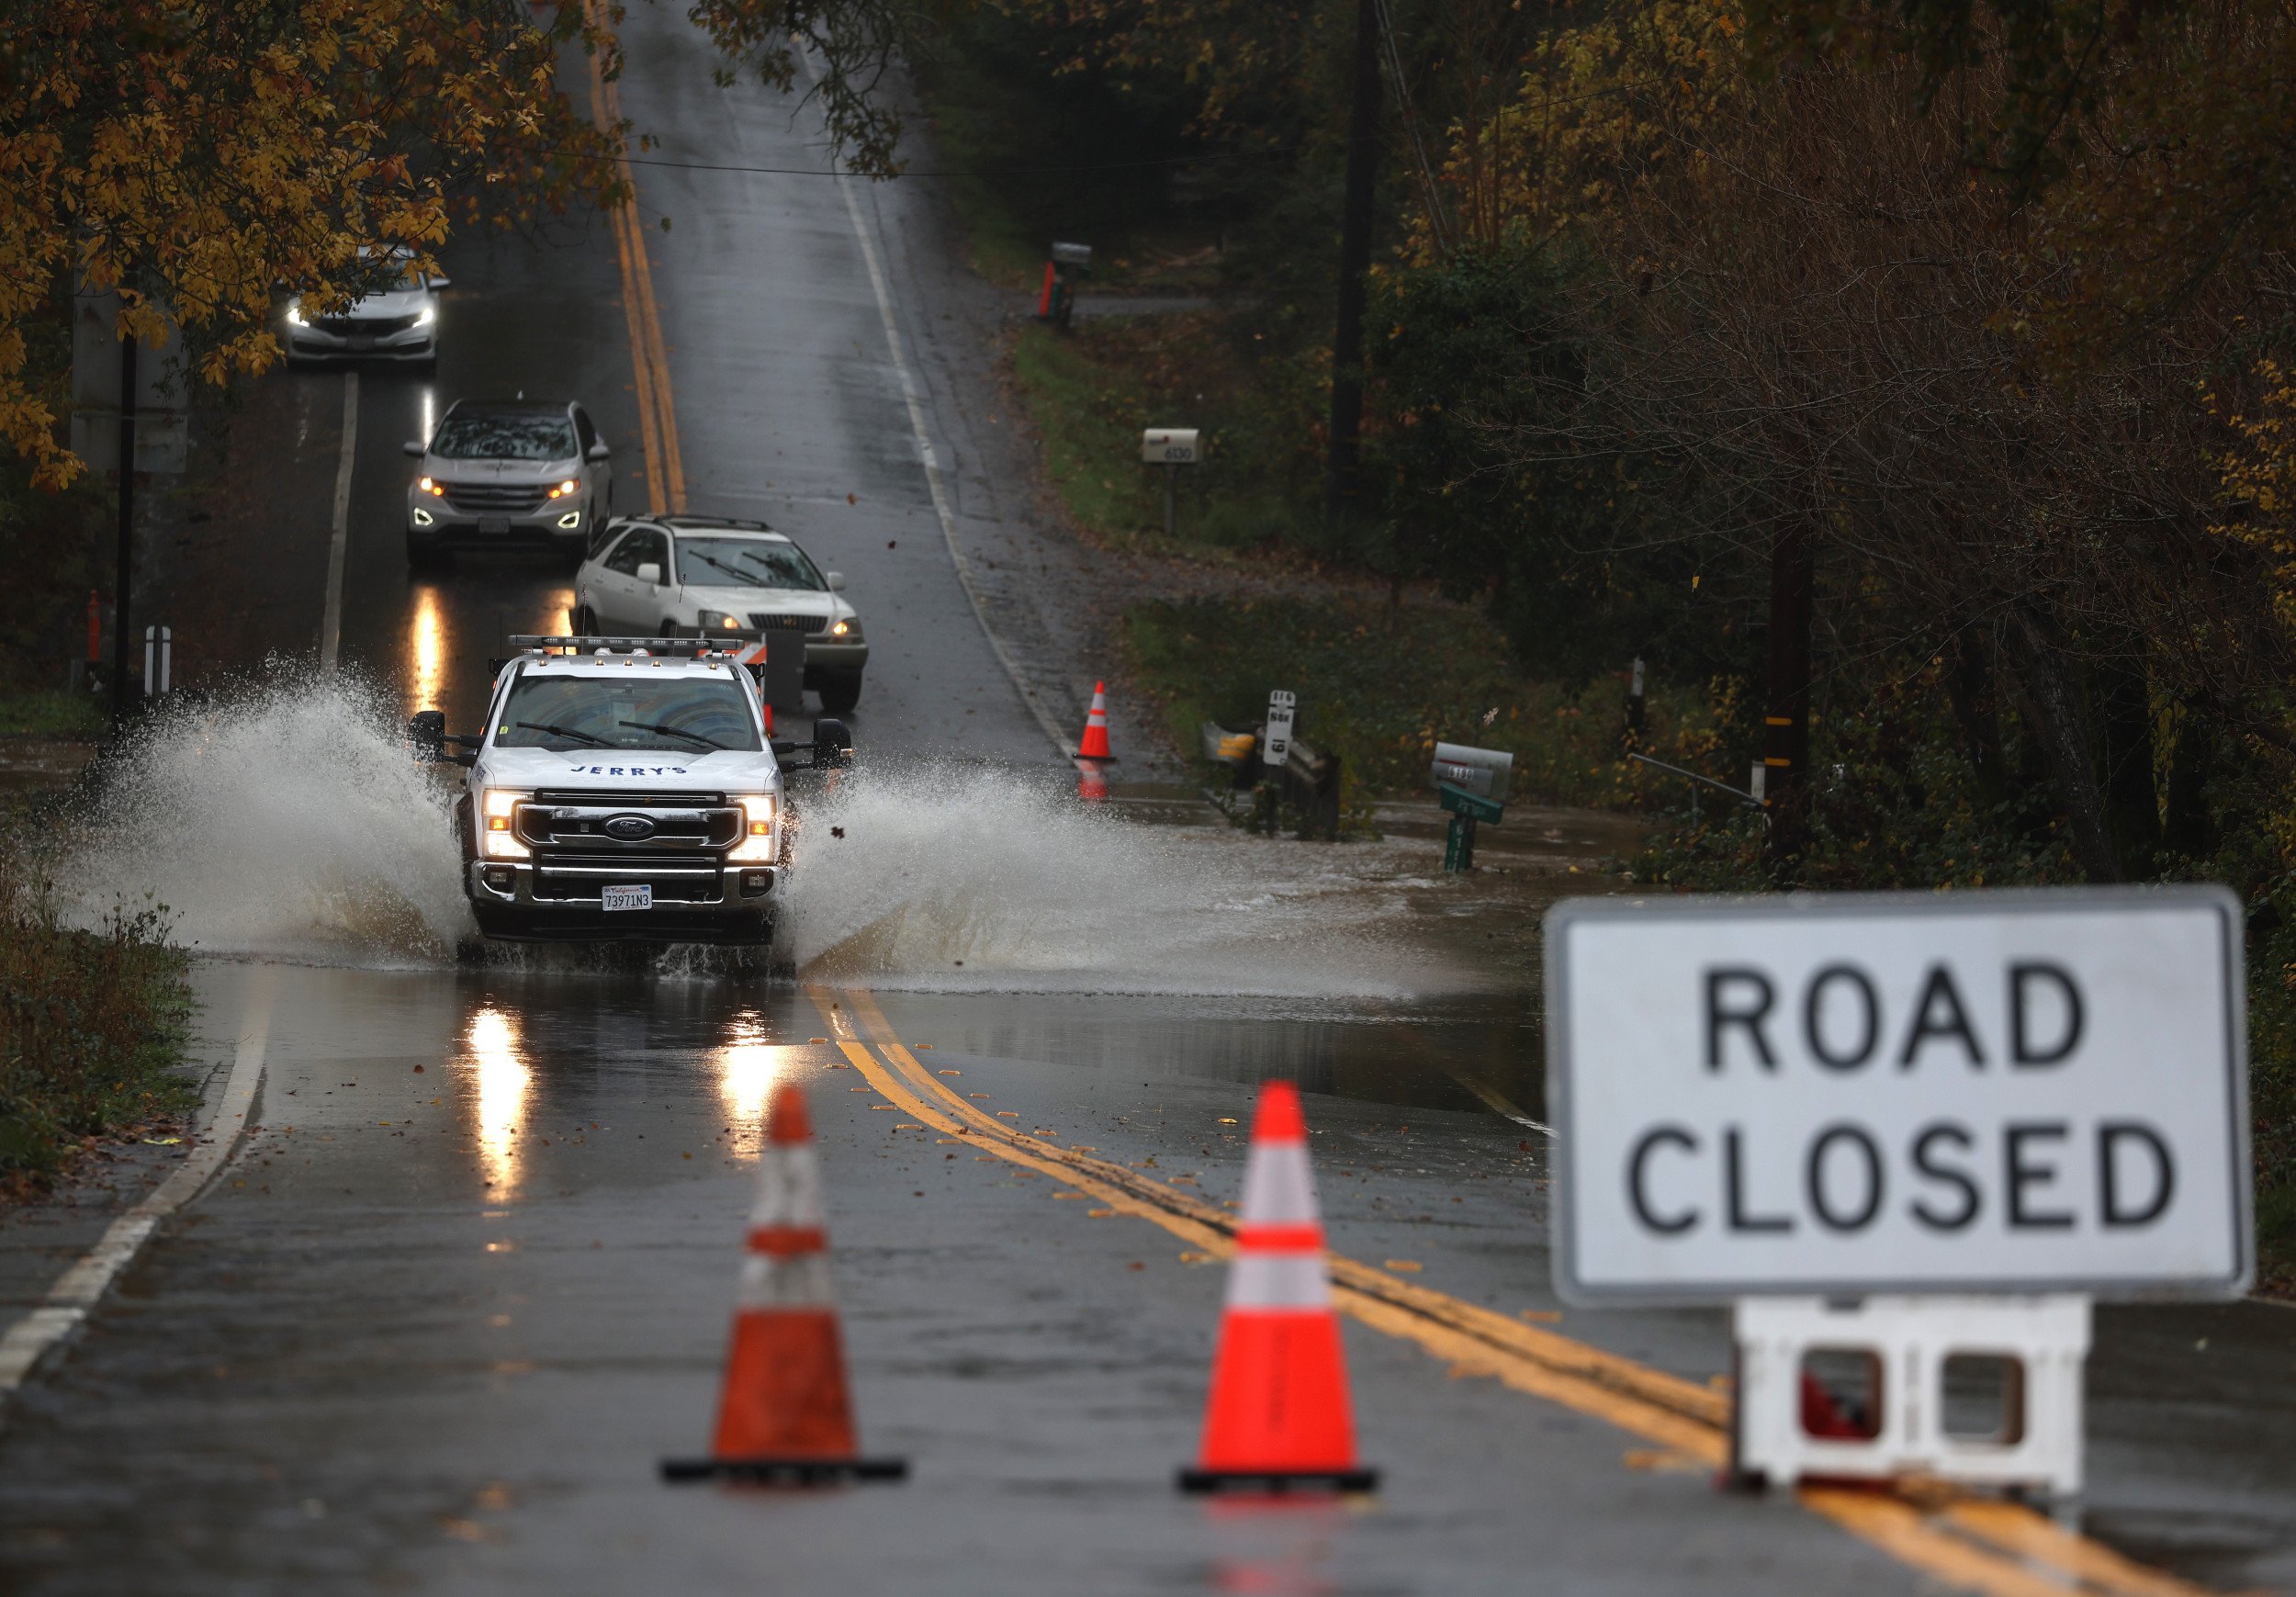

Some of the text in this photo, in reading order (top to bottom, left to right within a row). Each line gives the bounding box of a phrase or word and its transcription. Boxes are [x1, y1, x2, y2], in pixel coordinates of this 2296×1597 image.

[570, 766, 687, 776] JERRY'S
[617, 820, 643, 833] Ford
[606, 894, 648, 907] 73971N3
[1701, 958, 2087, 1073] ROAD
[1625, 1118, 2177, 1235] CLOSED
